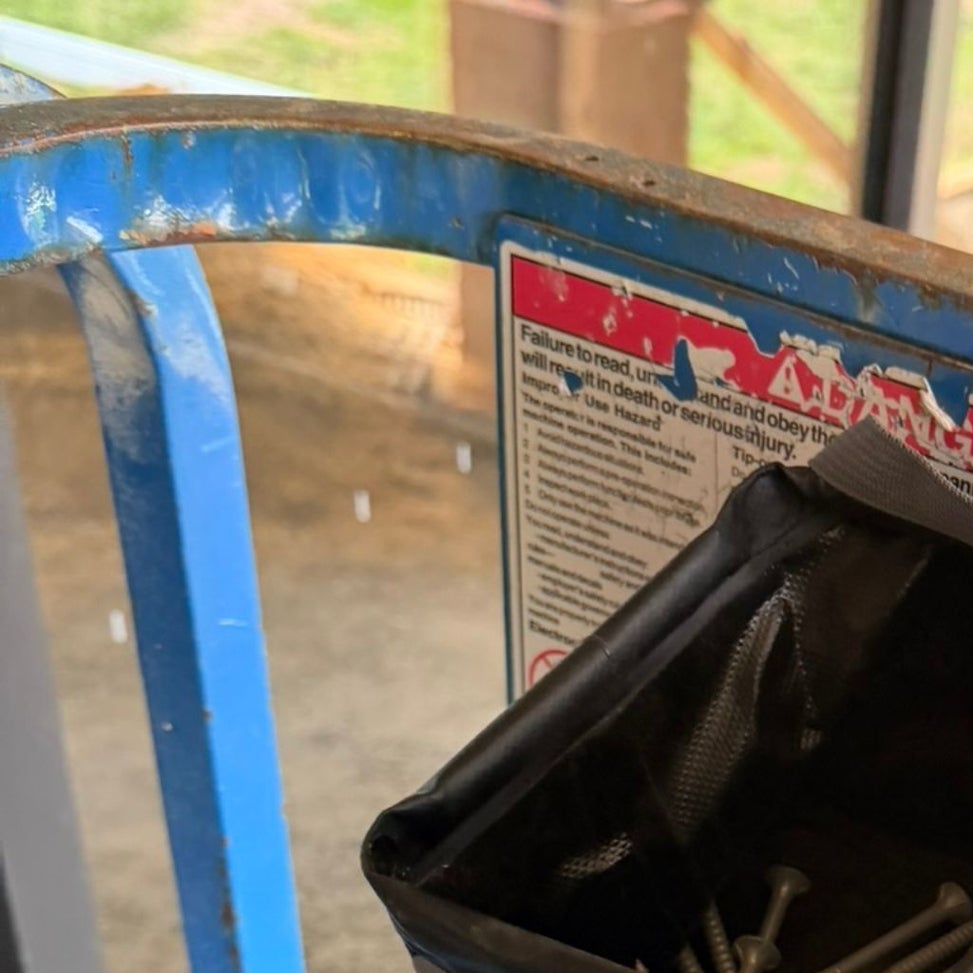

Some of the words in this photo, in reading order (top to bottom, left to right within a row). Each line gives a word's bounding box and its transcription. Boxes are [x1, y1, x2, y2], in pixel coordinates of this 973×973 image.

[520, 323, 575, 357] Failure
[576, 344, 592, 363] to
[594, 352, 634, 380] read,
[732, 401, 765, 424] and
[766, 412, 809, 443] obey
[520, 351, 547, 370] will
[596, 373, 614, 394] in
[614, 381, 659, 410] death
[661, 400, 678, 416] or
[680, 406, 744, 440] serious
[584, 394, 609, 413] Use
[614, 404, 661, 431] Hazard
